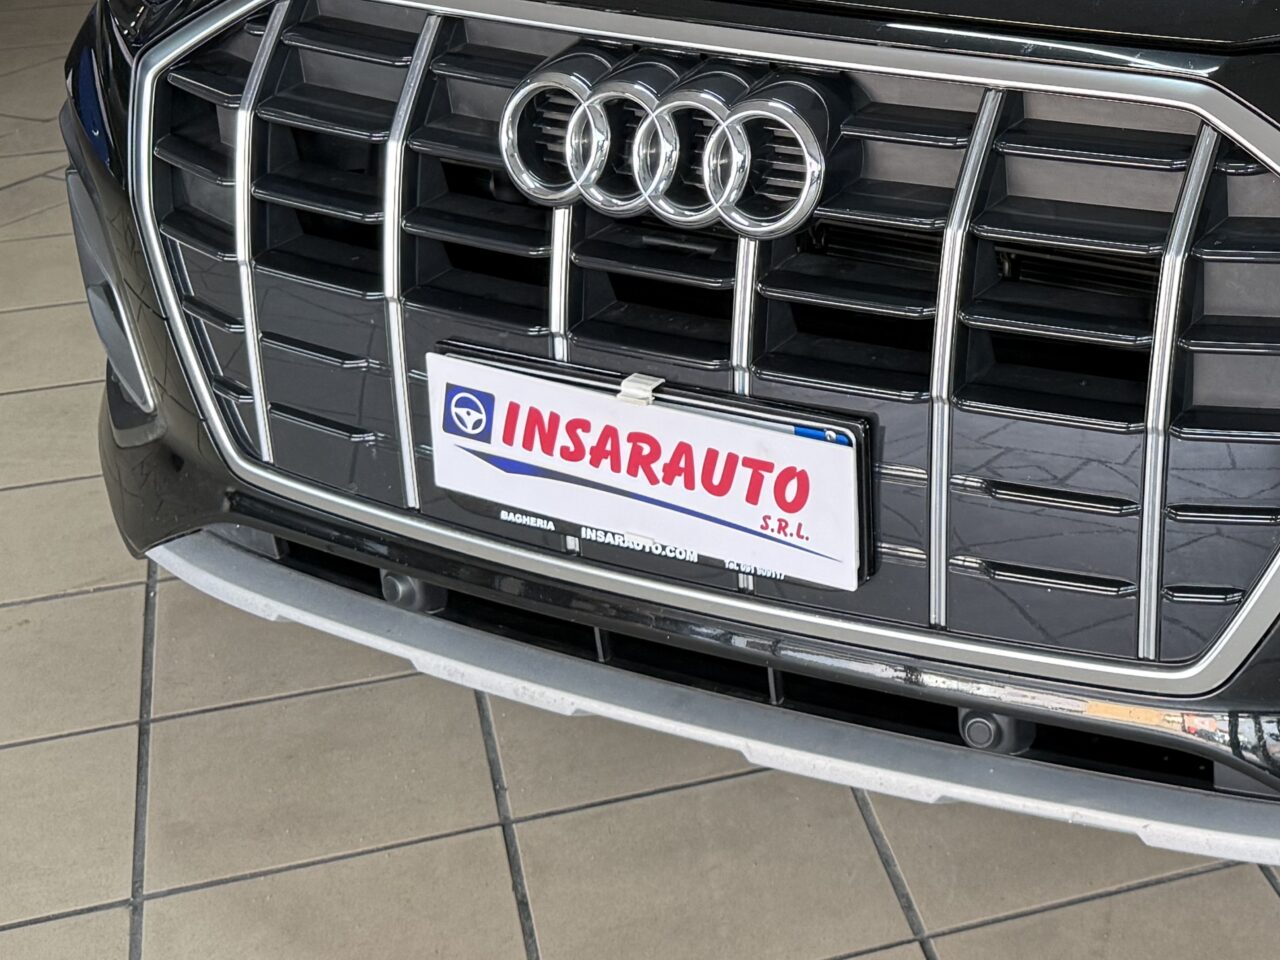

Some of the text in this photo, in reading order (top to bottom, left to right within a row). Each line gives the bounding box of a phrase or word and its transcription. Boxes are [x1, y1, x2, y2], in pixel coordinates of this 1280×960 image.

[502, 401, 810, 514] INSARAUTO
[500, 510, 555, 531] BAGHERIA
[760, 515, 809, 541] S.R.L.
[581, 526, 698, 562] INSARAUTO.COM
